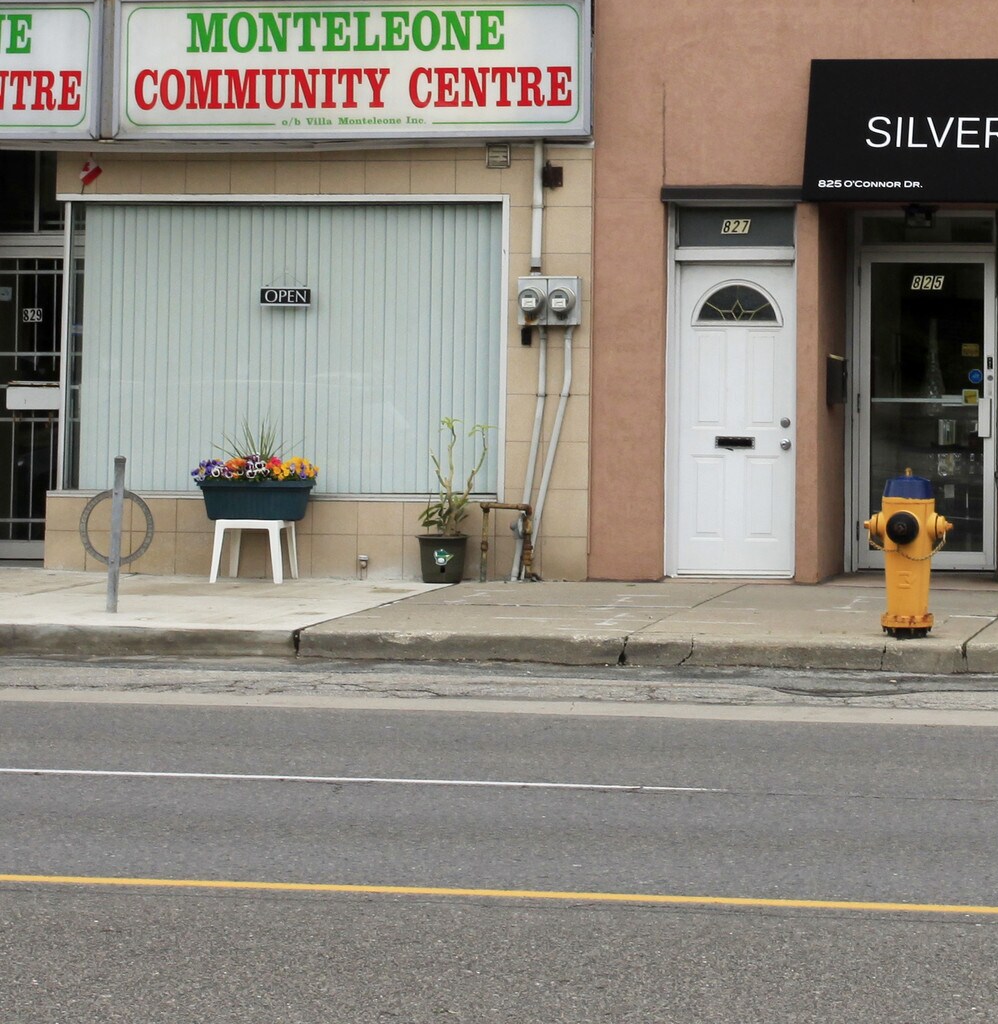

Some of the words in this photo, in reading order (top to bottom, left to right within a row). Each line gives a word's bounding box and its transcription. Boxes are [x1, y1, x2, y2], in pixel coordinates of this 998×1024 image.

[0, 14, 32, 54] E
[186, 10, 505, 53] MONTELEONE
[134, 68, 391, 110] COMMUNITY
[408, 66, 573, 107] CENTRE
[281, 117, 301, 126] o/b
[306, 117, 333, 126] Villa
[338, 116, 402, 125] Monteleone
[406, 116, 426, 125] Inc.
[818, 180, 842, 188] 825
[723, 220, 749, 233] 827
[912, 276, 943, 289] 825
[264, 289, 307, 303] OPEN
[23, 309, 42, 322] 829
